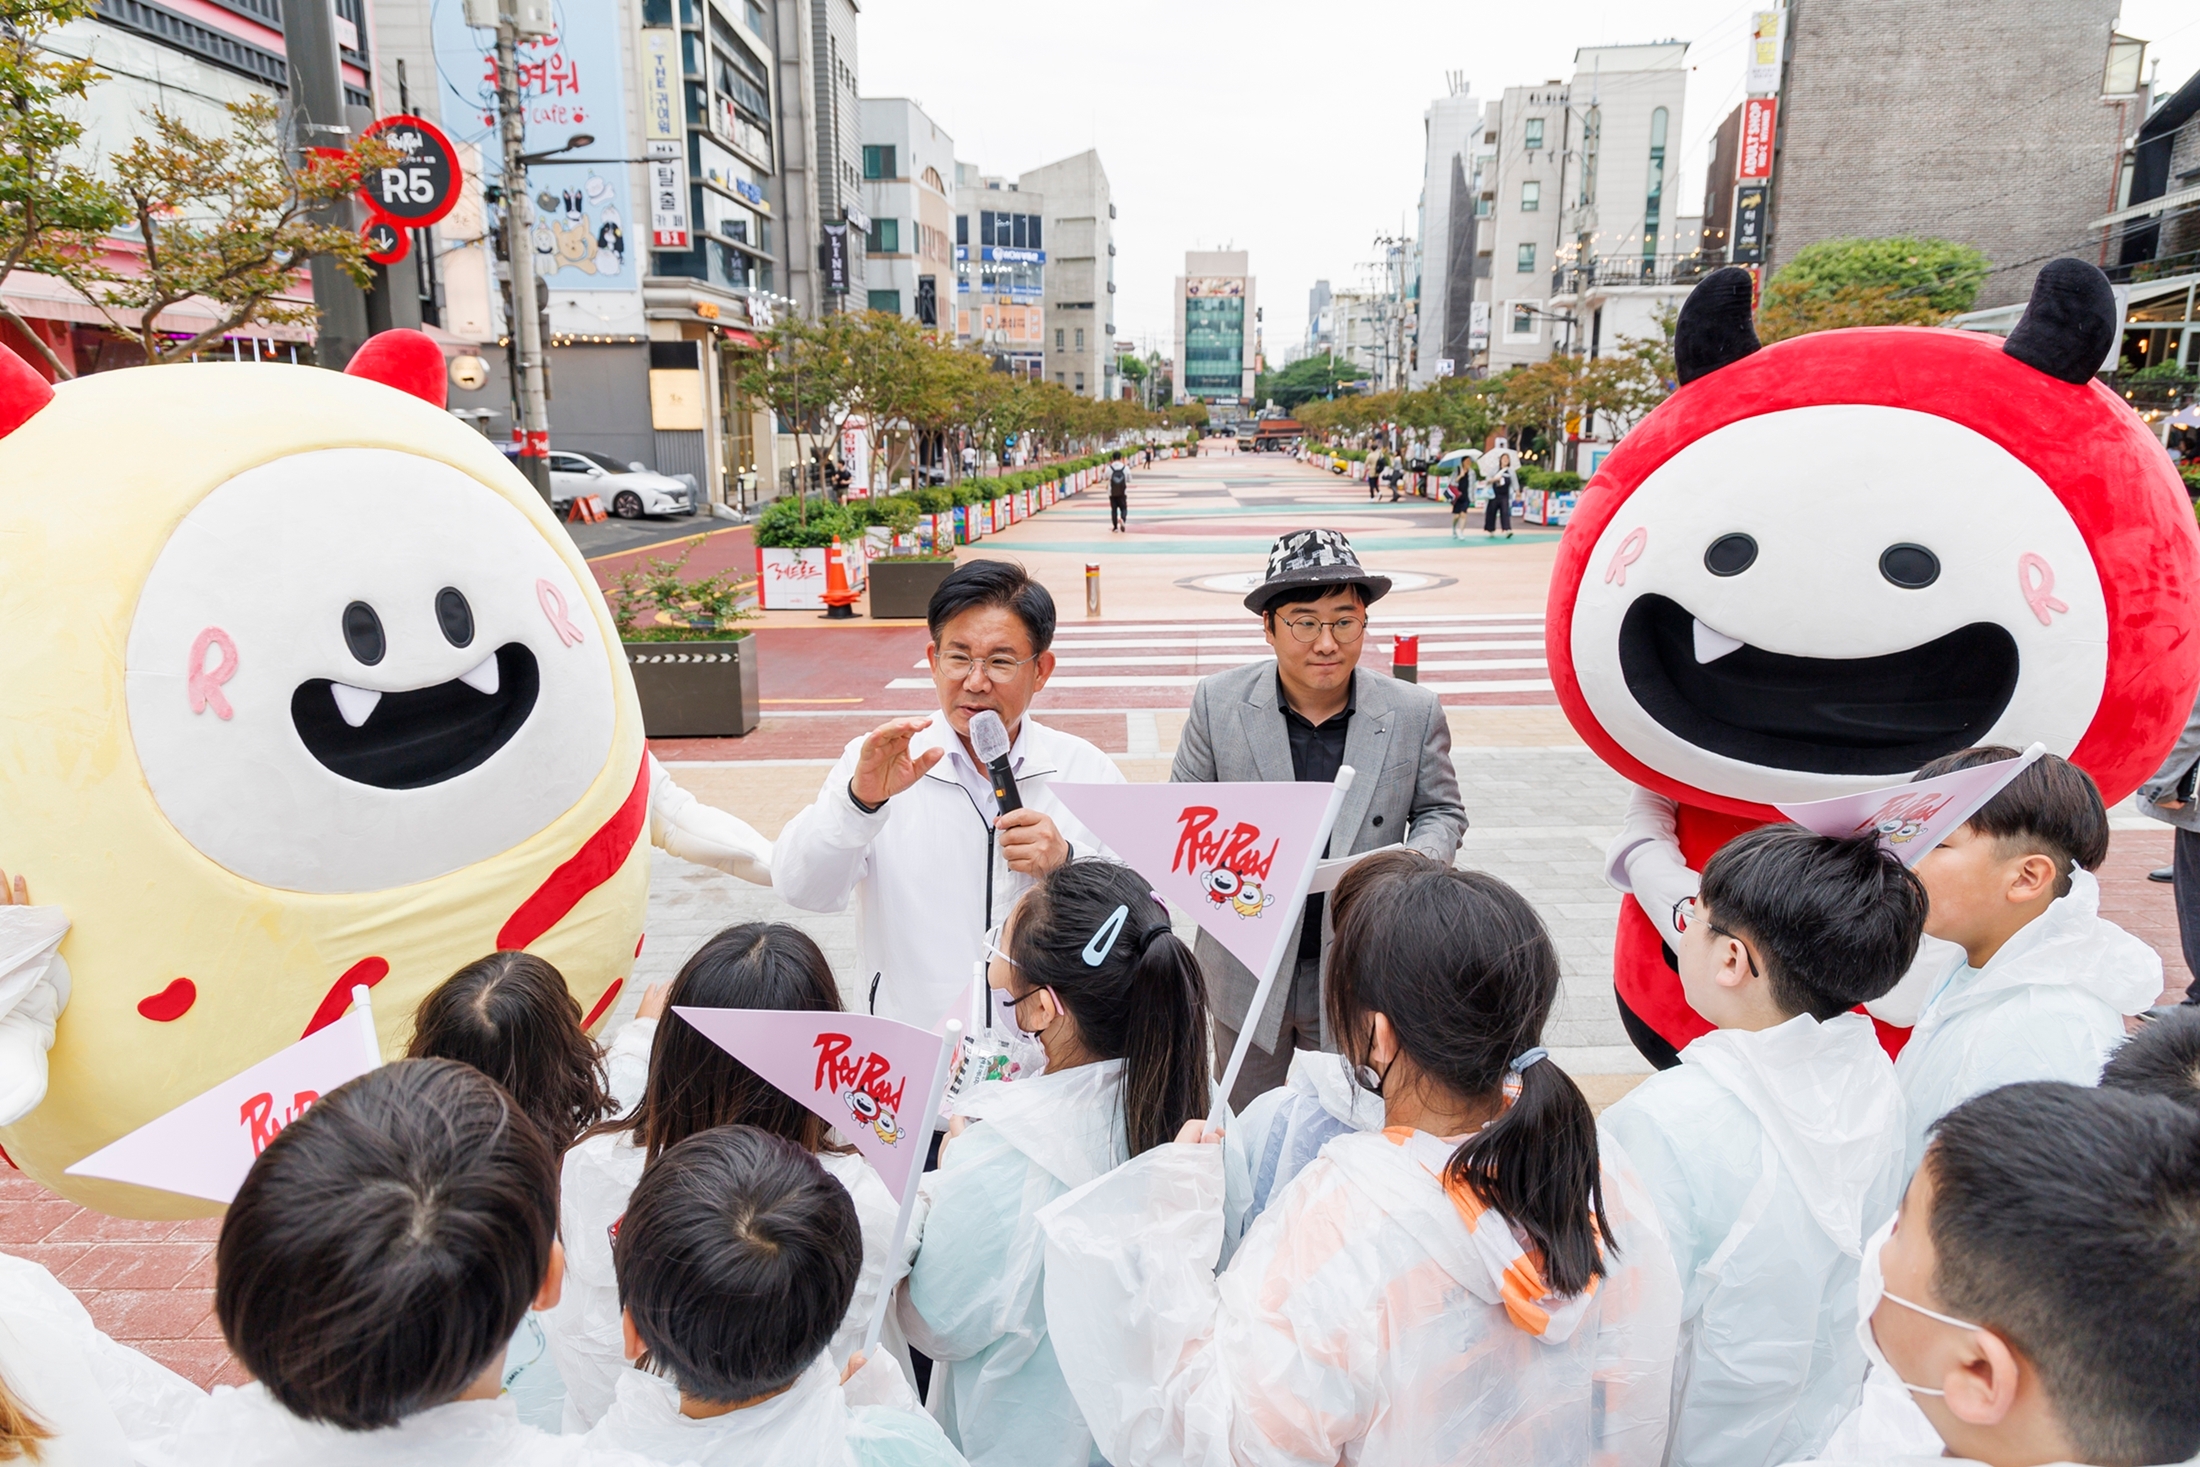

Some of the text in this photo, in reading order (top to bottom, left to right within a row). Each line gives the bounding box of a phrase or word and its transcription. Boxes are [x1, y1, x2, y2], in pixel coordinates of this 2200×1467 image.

[533, 104, 569, 124] cafe
[1748, 102, 1762, 135] SHOP
[1744, 135, 1759, 176] ADULT
[381, 167, 435, 204] R5
[660, 230, 681, 246] B1
[831, 236, 843, 281] LINE
[1604, 527, 1647, 586] R
[2017, 551, 2069, 627] R
[536, 578, 584, 647] R
[188, 626, 239, 720] R
